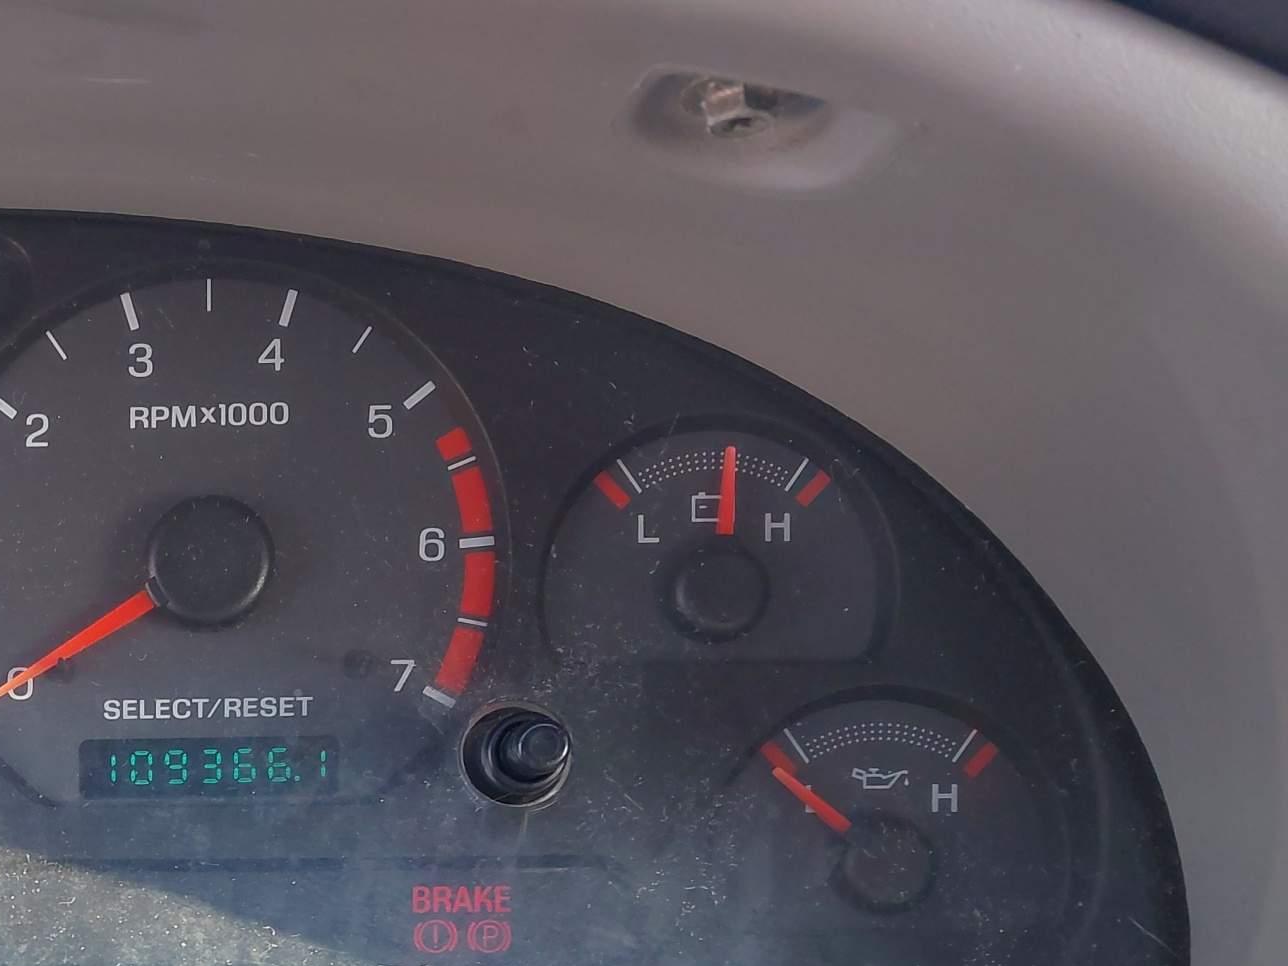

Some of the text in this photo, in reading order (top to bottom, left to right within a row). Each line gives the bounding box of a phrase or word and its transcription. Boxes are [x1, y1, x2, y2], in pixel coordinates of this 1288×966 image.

[128, 343, 153, 378] 3
[257, 338, 285, 372] 4
[25, 413, 49, 448] 2
[129, 402, 289, 429] RPMx1000
[368, 404, 393, 439] 5
[637, 514, 660, 544] L
[764, 512, 791, 542] H
[418, 527, 445, 562] 6
[7, 666, 34, 701] 0
[390, 659, 417, 692] 7
[103, 696, 313, 720] SELECT/RESET
[109, 747, 327, 785] 109366.1
[931, 783, 958, 813] H
[412, 885, 511, 913] BRAKE
